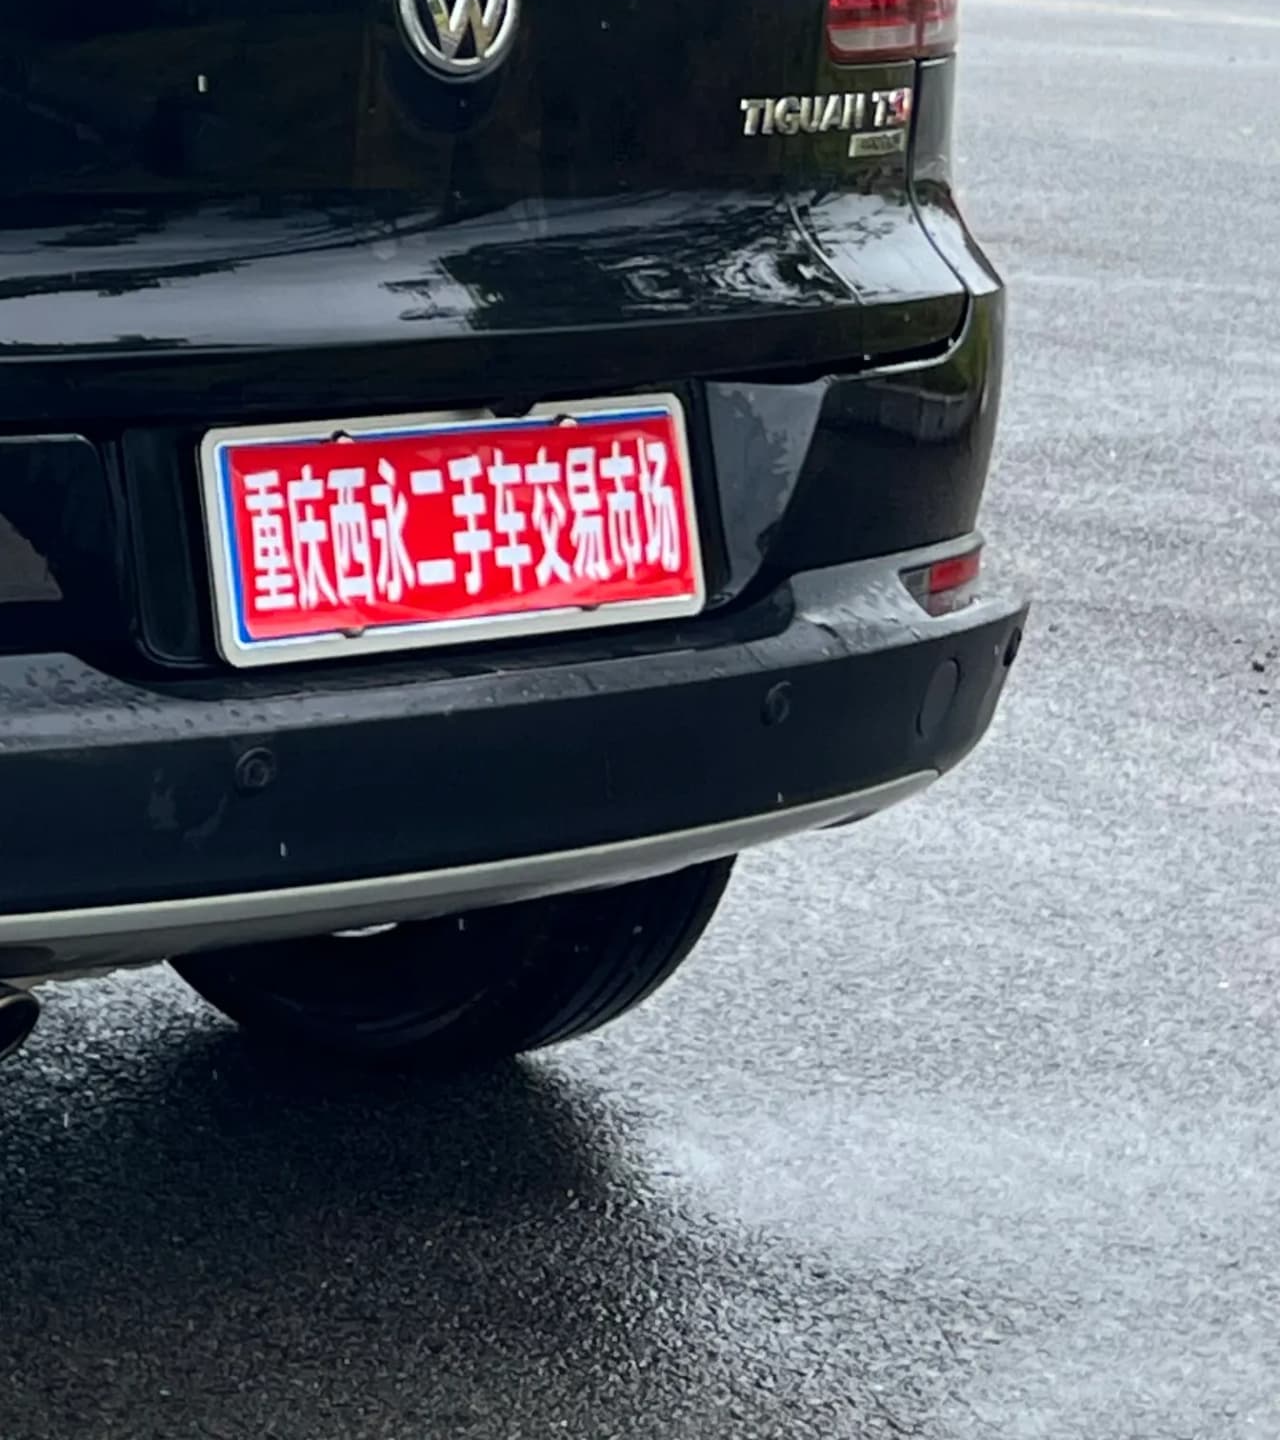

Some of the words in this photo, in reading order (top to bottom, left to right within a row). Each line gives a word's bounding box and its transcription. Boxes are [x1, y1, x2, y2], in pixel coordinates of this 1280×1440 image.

[242, 436, 682, 612] 重庆西永二手车交易市场
